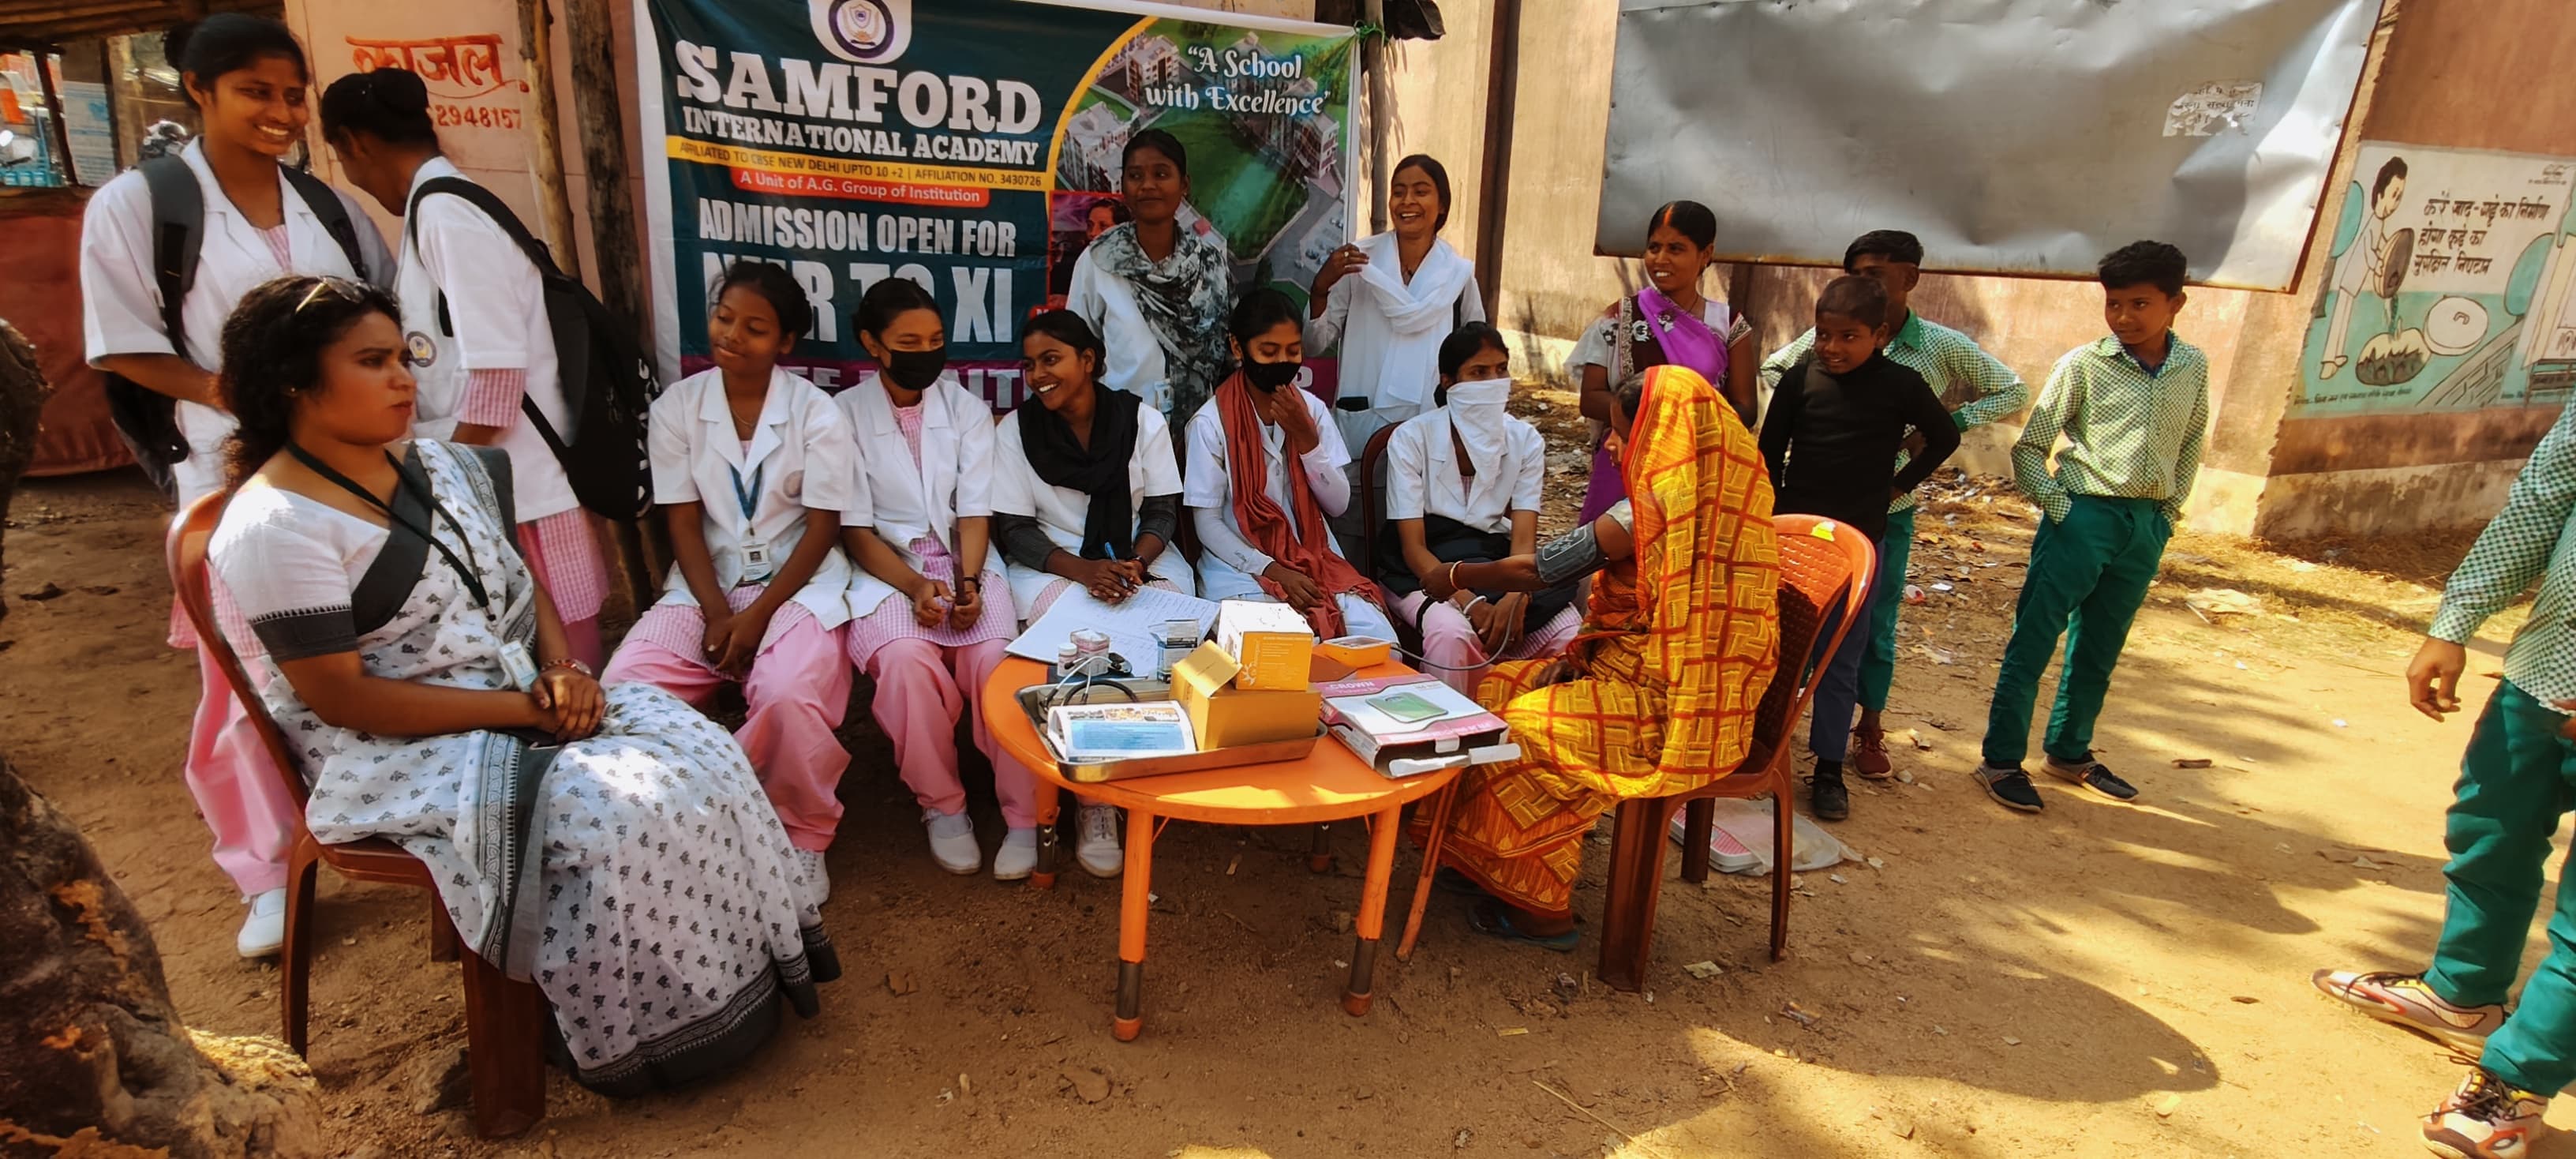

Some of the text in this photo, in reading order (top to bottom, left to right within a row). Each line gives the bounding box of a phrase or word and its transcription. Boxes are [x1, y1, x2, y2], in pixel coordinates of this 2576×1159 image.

[676, 39, 1041, 134] SAMFORD
[1223, 49, 1301, 79] School
[1145, 83, 1200, 110] with
[683, 106, 1039, 165] INTERNATIONAL ACADEMY
[734, 151, 749, 163] TO
[778, 157, 806, 170] NEW
[808, 159, 840, 172] DELHI
[843, 163, 872, 175] UPTO
[876, 166, 889, 178] 10
[892, 167, 904, 178] +2
[915, 168, 975, 182] AFFILIATION
[979, 171, 998, 184] NO.
[1000, 174, 1042, 187] 3430726
[740, 171, 980, 202] A Unit of A.G. Group of Institution
[699, 197, 1017, 257] ADMISSION OPEN FOR
[951, 266, 1013, 343] XI
